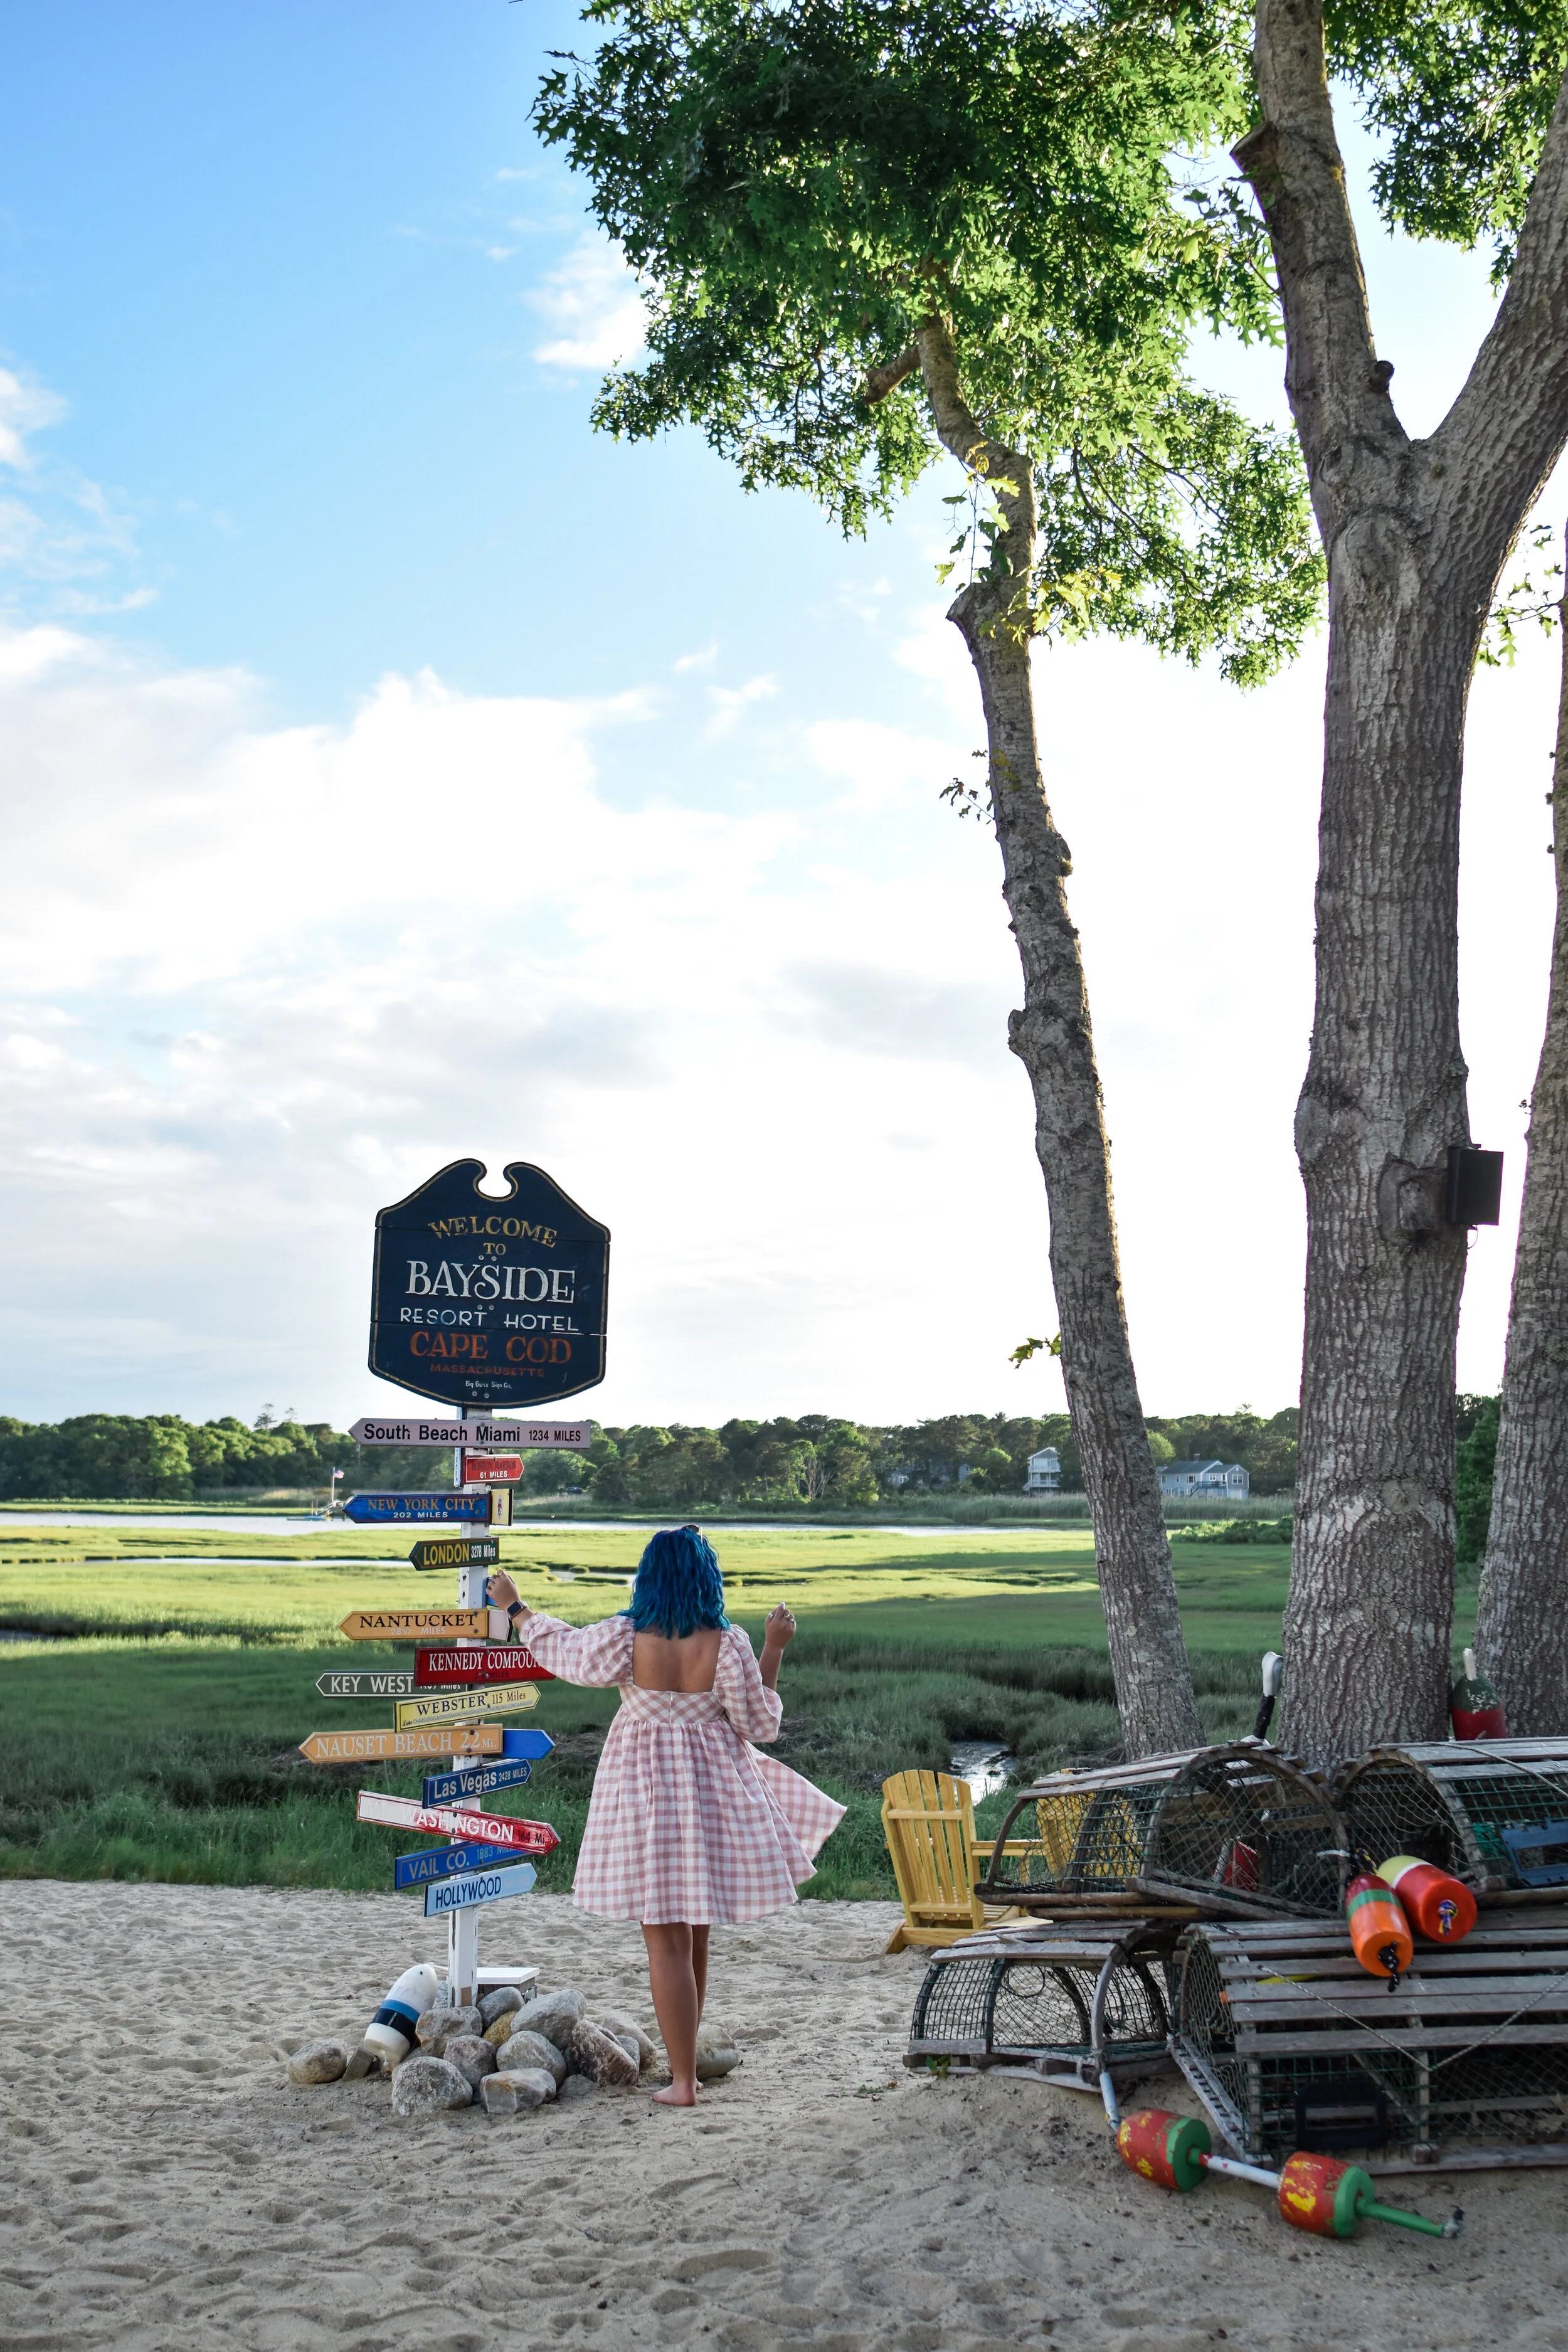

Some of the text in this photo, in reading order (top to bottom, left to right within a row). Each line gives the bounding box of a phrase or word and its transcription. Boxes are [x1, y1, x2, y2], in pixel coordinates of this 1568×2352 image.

[428, 1216, 558, 1248] WELCOME
[484, 1242, 506, 1256] TO
[405, 1260, 575, 1303] BAYSIDE
[400, 1307, 579, 1332] RESORT HOTEL
[410, 1331, 571, 1364] CAPE COD
[430, 1363, 545, 1377] MASSACHUSETTS
[465, 1380, 474, 1389] Big
[491, 1381, 502, 1389] Sign
[364, 1423, 581, 1442] South Beach Miami 1234 MILES
[489, 1470, 508, 1478] MILES
[368, 1498, 475, 1512] NEW YORK CITY
[423, 1543, 496, 1565] LONDON 3278 Miles
[359, 1614, 478, 1629] NANTUCKET
[429, 1652, 484, 1671] KENNEDY
[331, 1675, 361, 1693] KEY
[371, 1675, 413, 1693] WEST
[416, 1690, 526, 1716] WEBSTER 115 Miles
[403, 1717, 413, 1726] Lake
[317, 1732, 496, 1757] NAUSET BEACH 22 Mi.
[434, 1766, 527, 1799] Las Vegas 2428 MILES
[403, 1807, 514, 1842] WASHINGTON
[518, 1831, 531, 1843] 164
[535, 1834, 546, 1845] Mi.
[408, 1857, 439, 1880] VAIL
[446, 1850, 470, 1870] CO.
[477, 1846, 493, 1860] 1883
[435, 1876, 502, 1909] HOLLYWOOD
